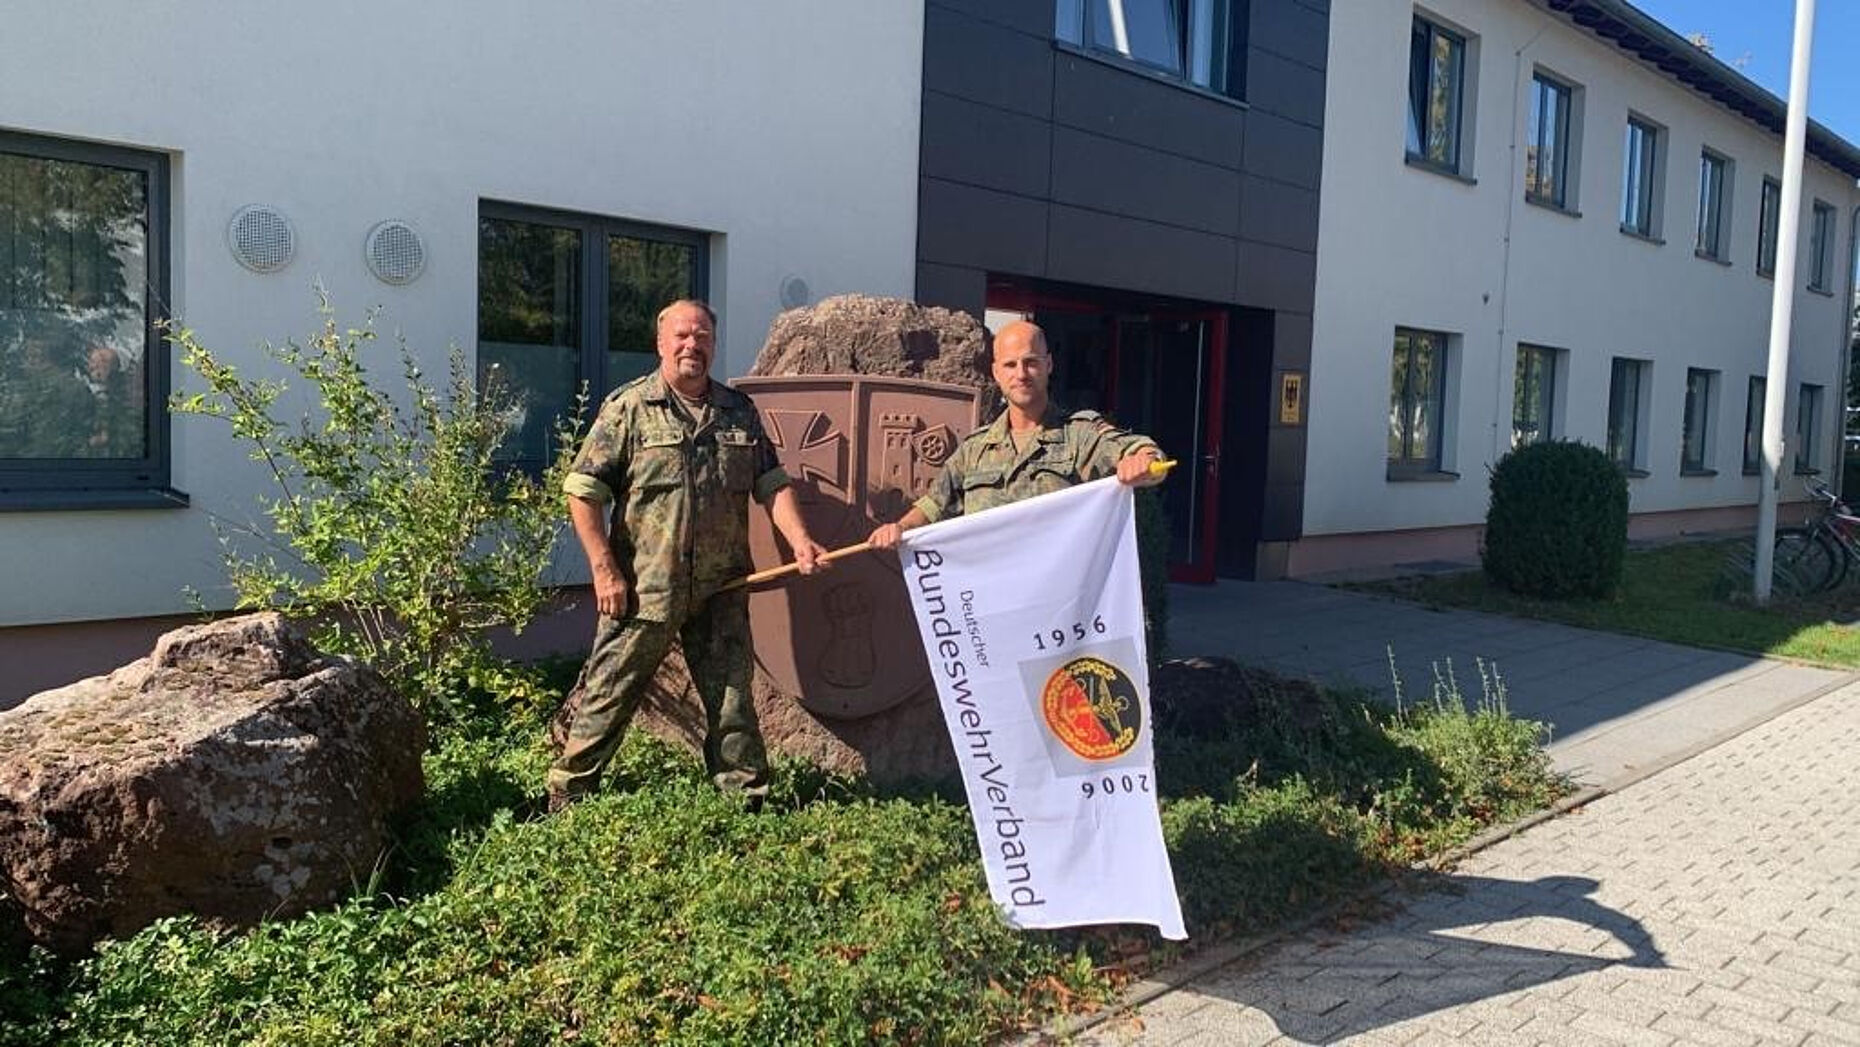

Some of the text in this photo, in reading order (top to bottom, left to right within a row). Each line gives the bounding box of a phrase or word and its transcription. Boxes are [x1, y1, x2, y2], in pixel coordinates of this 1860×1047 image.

[960, 590, 989, 668] Deutscher
[1034, 615, 1106, 650] 1956
[1081, 774, 1149, 799] 2006
